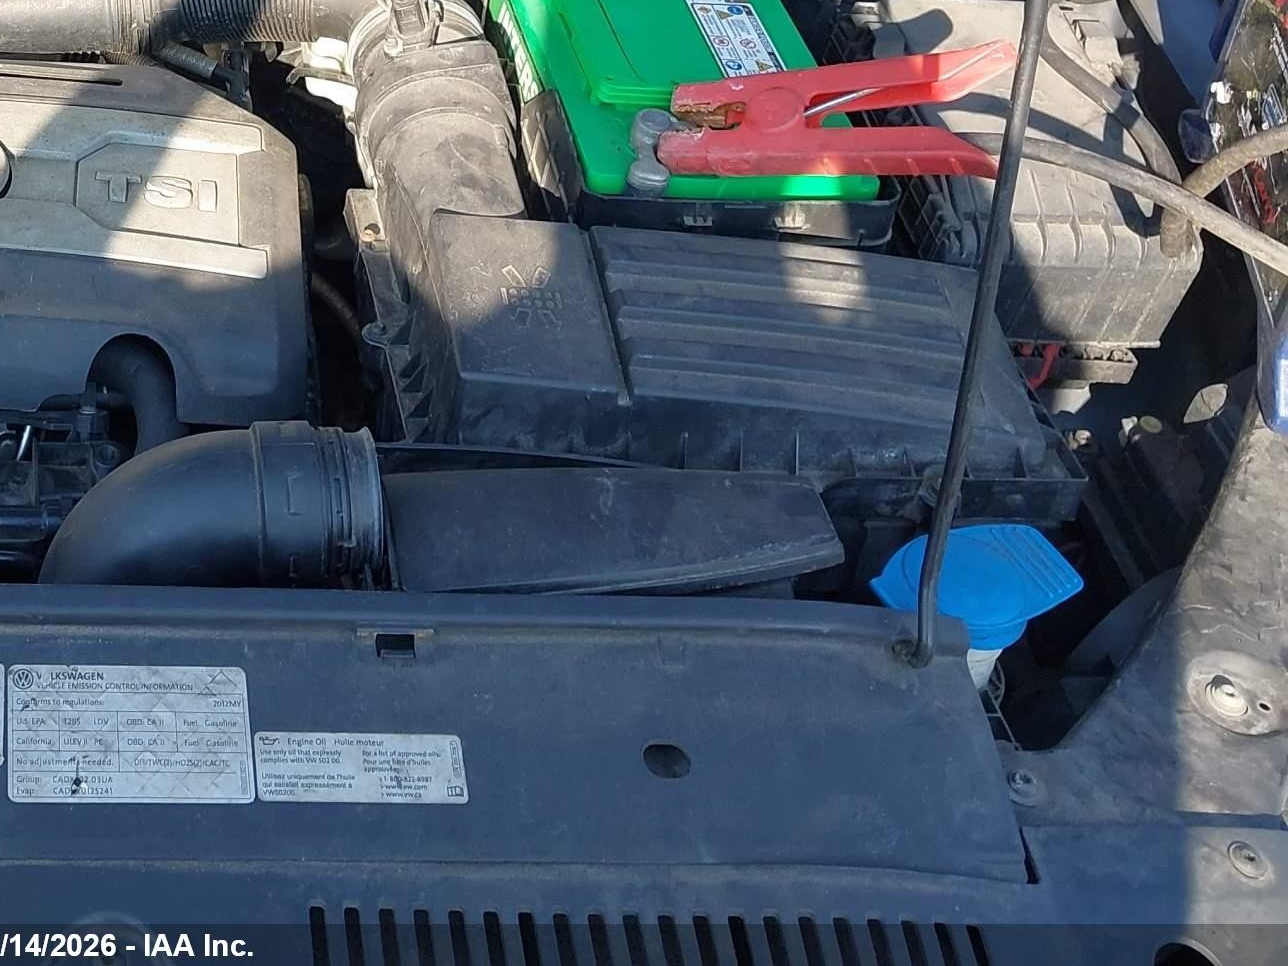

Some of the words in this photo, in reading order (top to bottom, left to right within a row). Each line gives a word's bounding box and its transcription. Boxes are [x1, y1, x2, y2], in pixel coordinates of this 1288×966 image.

[94, 171, 219, 213] TSI
[35, 671, 104, 680] VLKSWAGEN
[67, 682, 103, 690] EMISSION
[105, 682, 141, 690] CONTROL
[142, 682, 193, 691] INFORMATION
[287, 738, 314, 747] Engine
[315, 738, 327, 746] Oil
[334, 738, 354, 746] Huile
[356, 739, 385, 747] moteur
[16, 757, 27, 766] No
